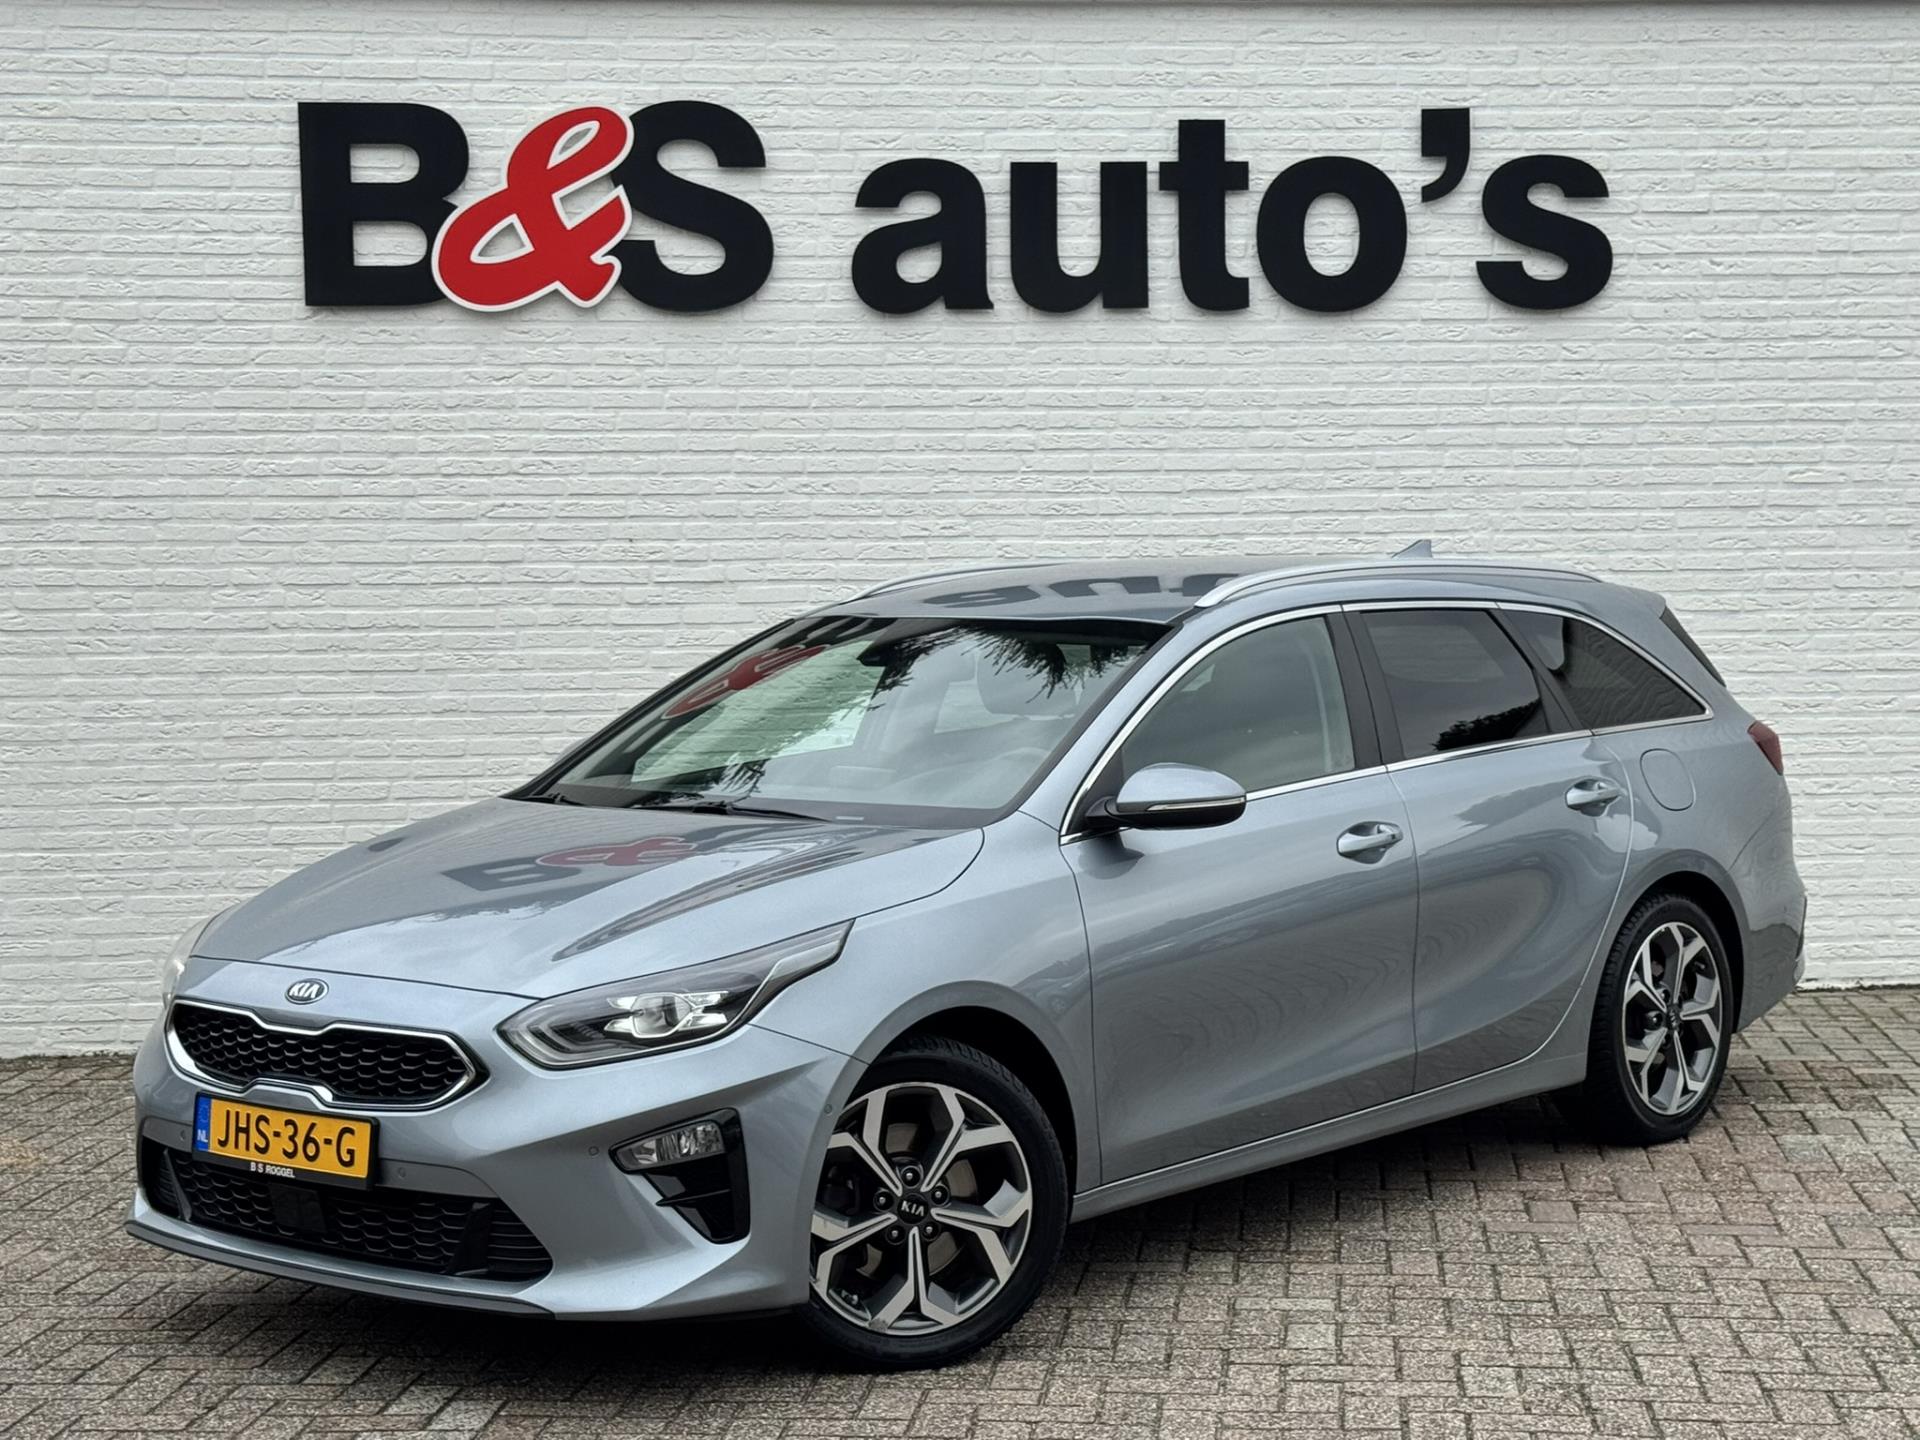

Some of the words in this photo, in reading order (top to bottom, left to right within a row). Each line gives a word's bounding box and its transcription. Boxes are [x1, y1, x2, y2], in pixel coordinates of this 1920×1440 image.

[297, 100, 774, 312] B&S
[851, 107, 1614, 314] auto's
[288, 982, 320, 999] KIA
[197, 1128, 209, 1143] NL
[217, 1109, 356, 1168] JHS-36-G
[250, 1161, 257, 1172] B
[257, 1162, 264, 1173] S
[901, 1200, 925, 1217] KIA
